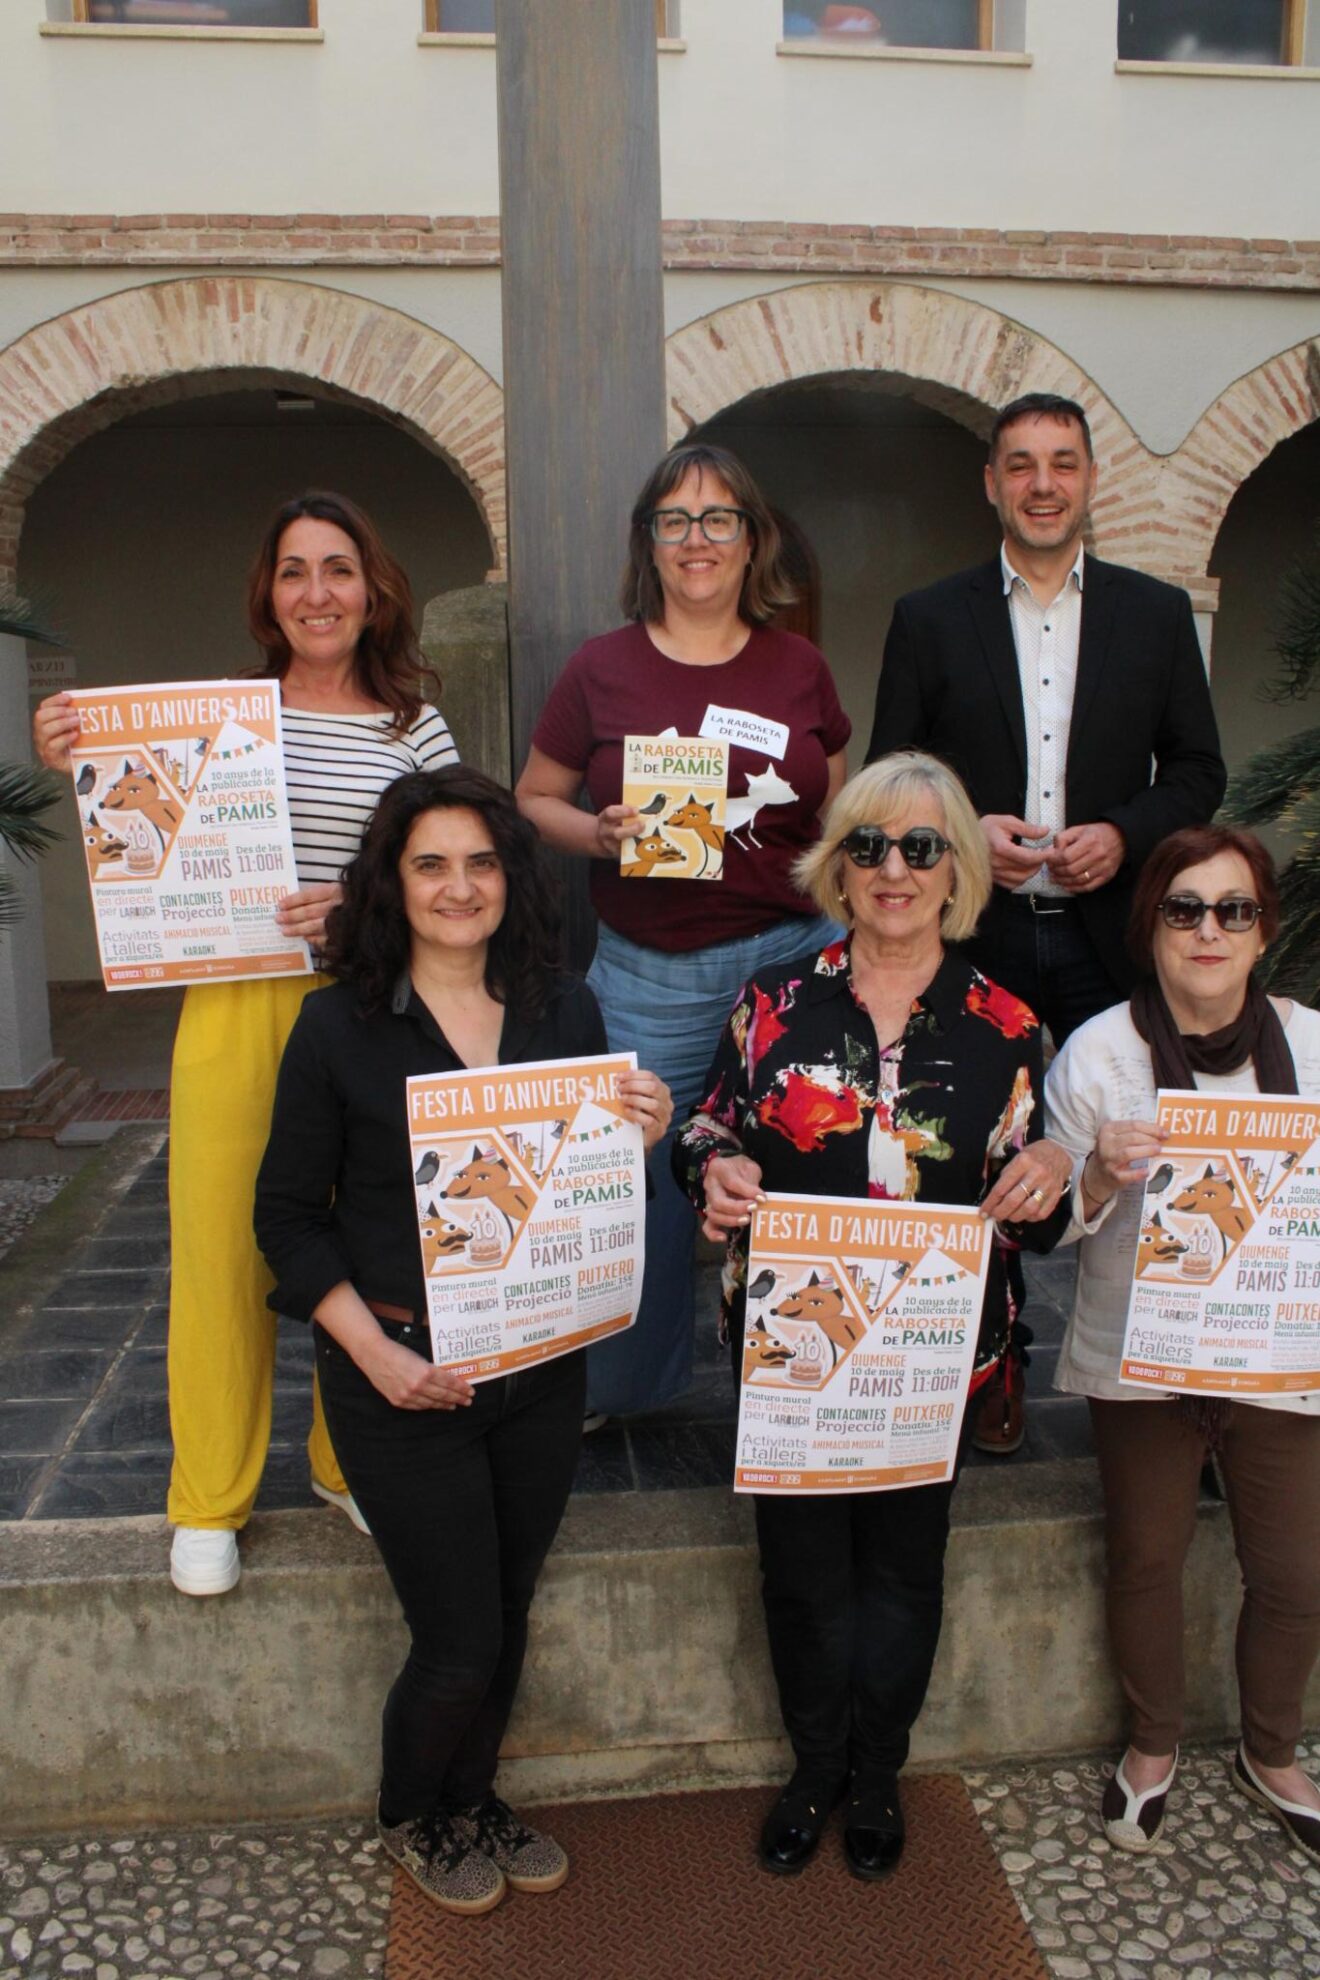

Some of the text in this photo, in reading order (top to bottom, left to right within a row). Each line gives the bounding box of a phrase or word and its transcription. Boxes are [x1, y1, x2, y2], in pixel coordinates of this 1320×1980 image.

[79, 696, 271, 734] ESTA D'ANIVERSARI
[711, 715, 781, 739] LA RABOSETA
[720, 728, 768, 745] DE PAMIS
[629, 744, 641, 752] LA
[644, 744, 723, 759] RABOSETA
[212, 772, 221, 780] 10
[251, 768, 263, 777] de
[644, 758, 723, 776] DE PAMIS
[196, 784, 208, 793] LA
[264, 778, 276, 786] de
[198, 790, 275, 807] RABOSETA
[200, 802, 277, 824] DE PAMIS
[125, 829, 149, 850] 10
[178, 833, 228, 849] DIUMENGE
[180, 848, 229, 858] 10 de maig
[236, 844, 282, 854] Des de les
[181, 858, 232, 881] PAMIS
[238, 853, 284, 873] 11:00H
[160, 892, 223, 908] CONTACONTES
[102, 930, 160, 942] Activitats
[112, 942, 162, 956] tallers
[412, 1074, 621, 1120] FESTA D'ANIVERSAR
[1160, 1107, 1217, 1136] FESTA
[568, 1148, 633, 1163] 10 anys de la
[622, 1157, 635, 1166] de
[552, 1168, 564, 1177] LA
[552, 1170, 633, 1192] RABOSETA
[554, 1198, 570, 1209] DE
[573, 1182, 634, 1206] PAMIS
[1290, 1186, 1301, 1194] 10
[1272, 1196, 1284, 1205] LA
[471, 1219, 497, 1240] 10
[528, 1216, 582, 1237] DIUMENGE
[590, 1222, 635, 1236] Des de les
[755, 1210, 982, 1252] FESTA D'ANIVERSARI
[1268, 1226, 1284, 1236] DE
[530, 1232, 582, 1246] 10 de maig
[590, 1229, 635, 1254] 11:00H
[1188, 1234, 1211, 1255] 10
[530, 1240, 583, 1269] PAMIS
[1240, 1245, 1291, 1260] DIUMENGE
[578, 1258, 634, 1287] PUTXERO
[1239, 1260, 1289, 1271] 10 de maig
[1296, 1262, 1313, 1270] Des
[504, 1275, 571, 1298] CONTACONTES
[1236, 1270, 1287, 1292] PAMIS
[434, 1302, 456, 1316] per
[905, 1297, 972, 1307] 10 anys de la
[1205, 1302, 1270, 1317] CONTACONTES
[885, 1307, 899, 1315] LA
[960, 1306, 972, 1315] de
[437, 1321, 501, 1340] Activitats
[884, 1318, 967, 1330] RABOSETA
[522, 1326, 555, 1343] KARAOKE
[882, 1330, 966, 1345] DE PAMIS
[1130, 1327, 1195, 1345] Activitats
[448, 1334, 501, 1354] tallers
[794, 1341, 821, 1362] 10
[1140, 1341, 1193, 1358] tallers
[851, 1354, 907, 1368] DIUMENGE
[864, 1367, 877, 1376] de
[878, 1368, 905, 1377] maig
[913, 1366, 961, 1376] Des de les
[849, 1377, 904, 1398] PAMIS
[912, 1376, 960, 1393] 11:00H
[746, 1392, 811, 1405] Pintura mural
[744, 1410, 765, 1421] per
[817, 1408, 886, 1421] CONTACONTES
[893, 1402, 954, 1422] PUTXERO
[816, 1420, 885, 1435] Projecció
[742, 1434, 808, 1448] Activitats
[852, 1440, 884, 1449] MUSICAL
[752, 1448, 806, 1461] tallers
[828, 1457, 864, 1466] KARAOKE
